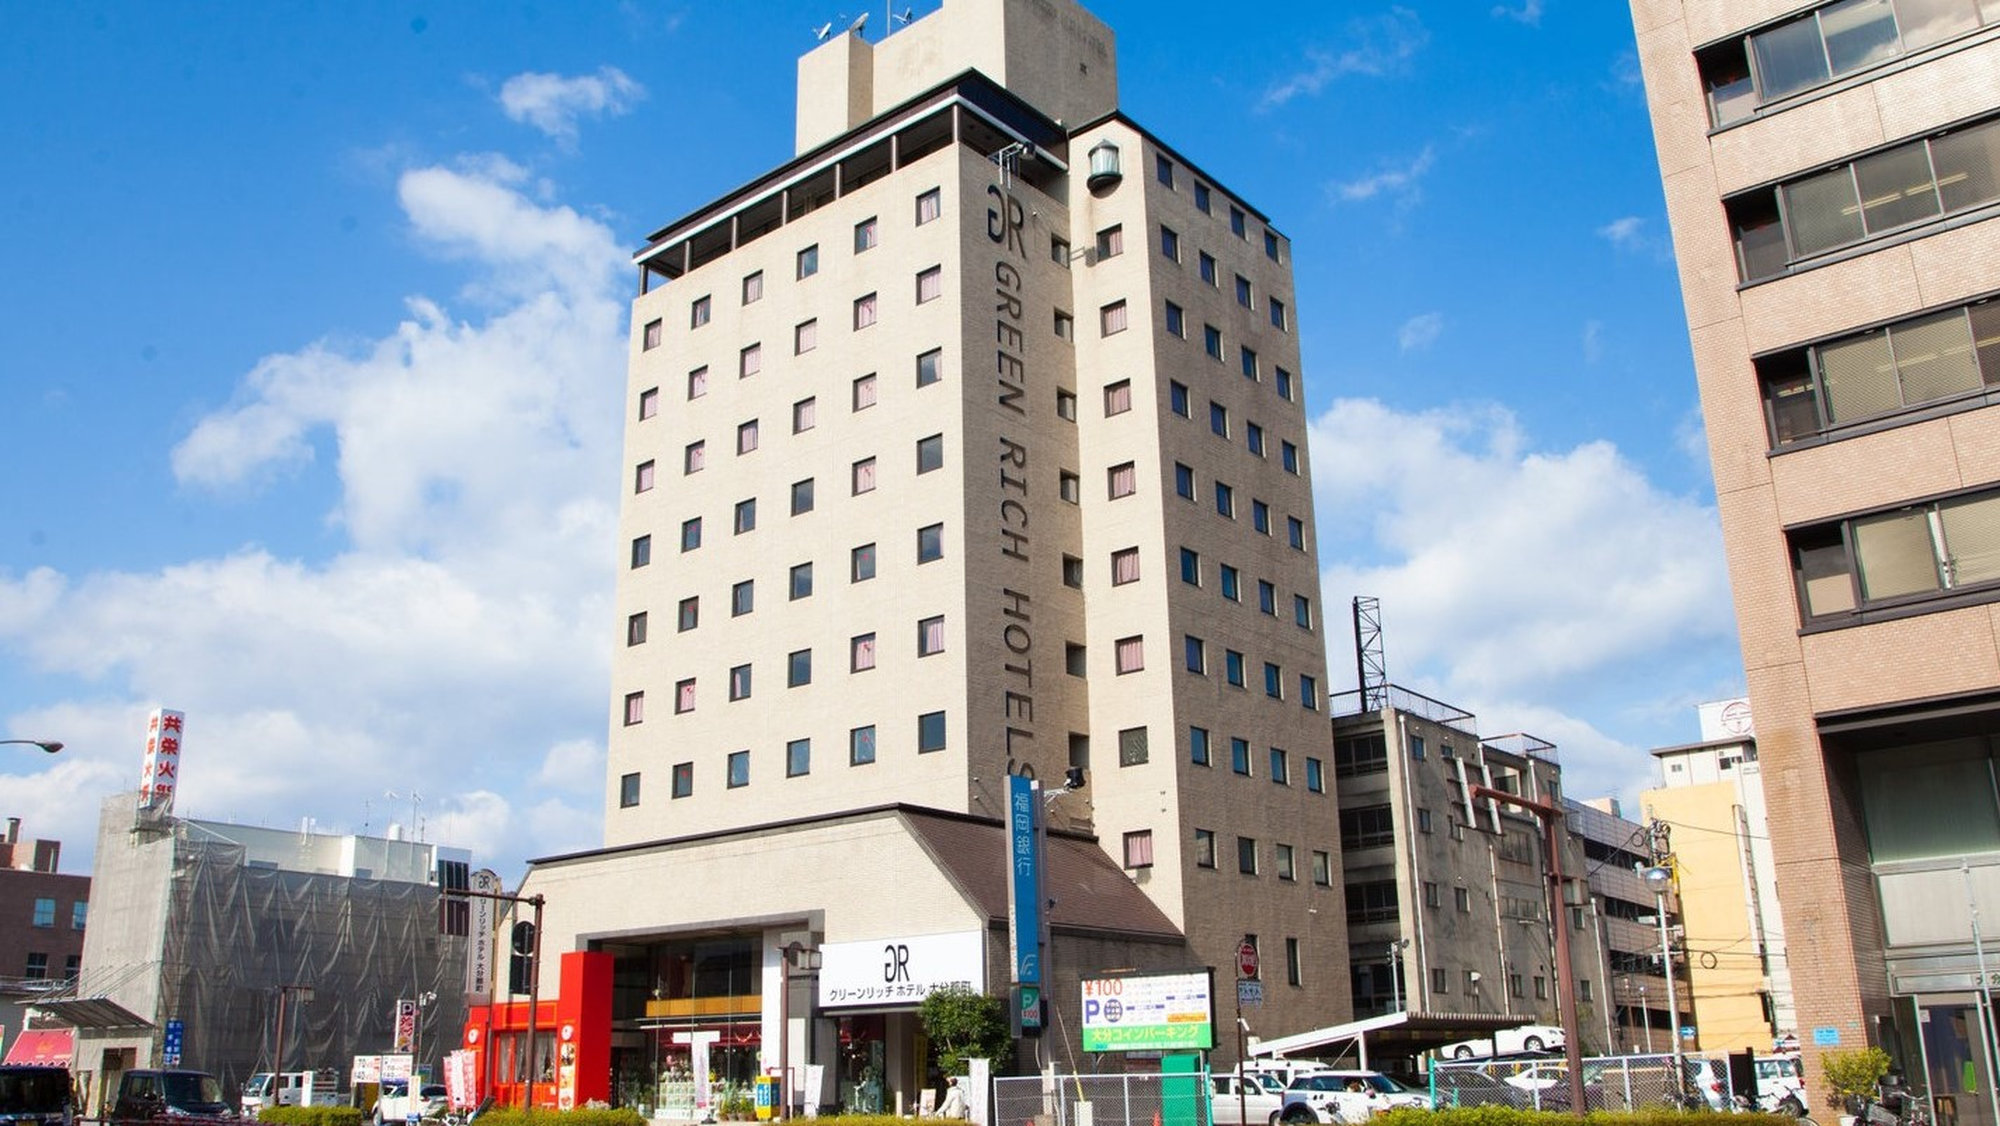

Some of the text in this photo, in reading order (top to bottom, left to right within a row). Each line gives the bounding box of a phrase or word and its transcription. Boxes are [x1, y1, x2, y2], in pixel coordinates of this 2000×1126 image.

[995, 260, 1025, 416] GREEN
[999, 436, 1029, 562] RICH
[1014, 792, 1032, 877] 福岡銀行
[896, 982, 926, 996] ホテル
[1085, 979, 1123, 997] ¥100
[1022, 994, 1033, 1009] P
[1085, 999, 1100, 1024] P
